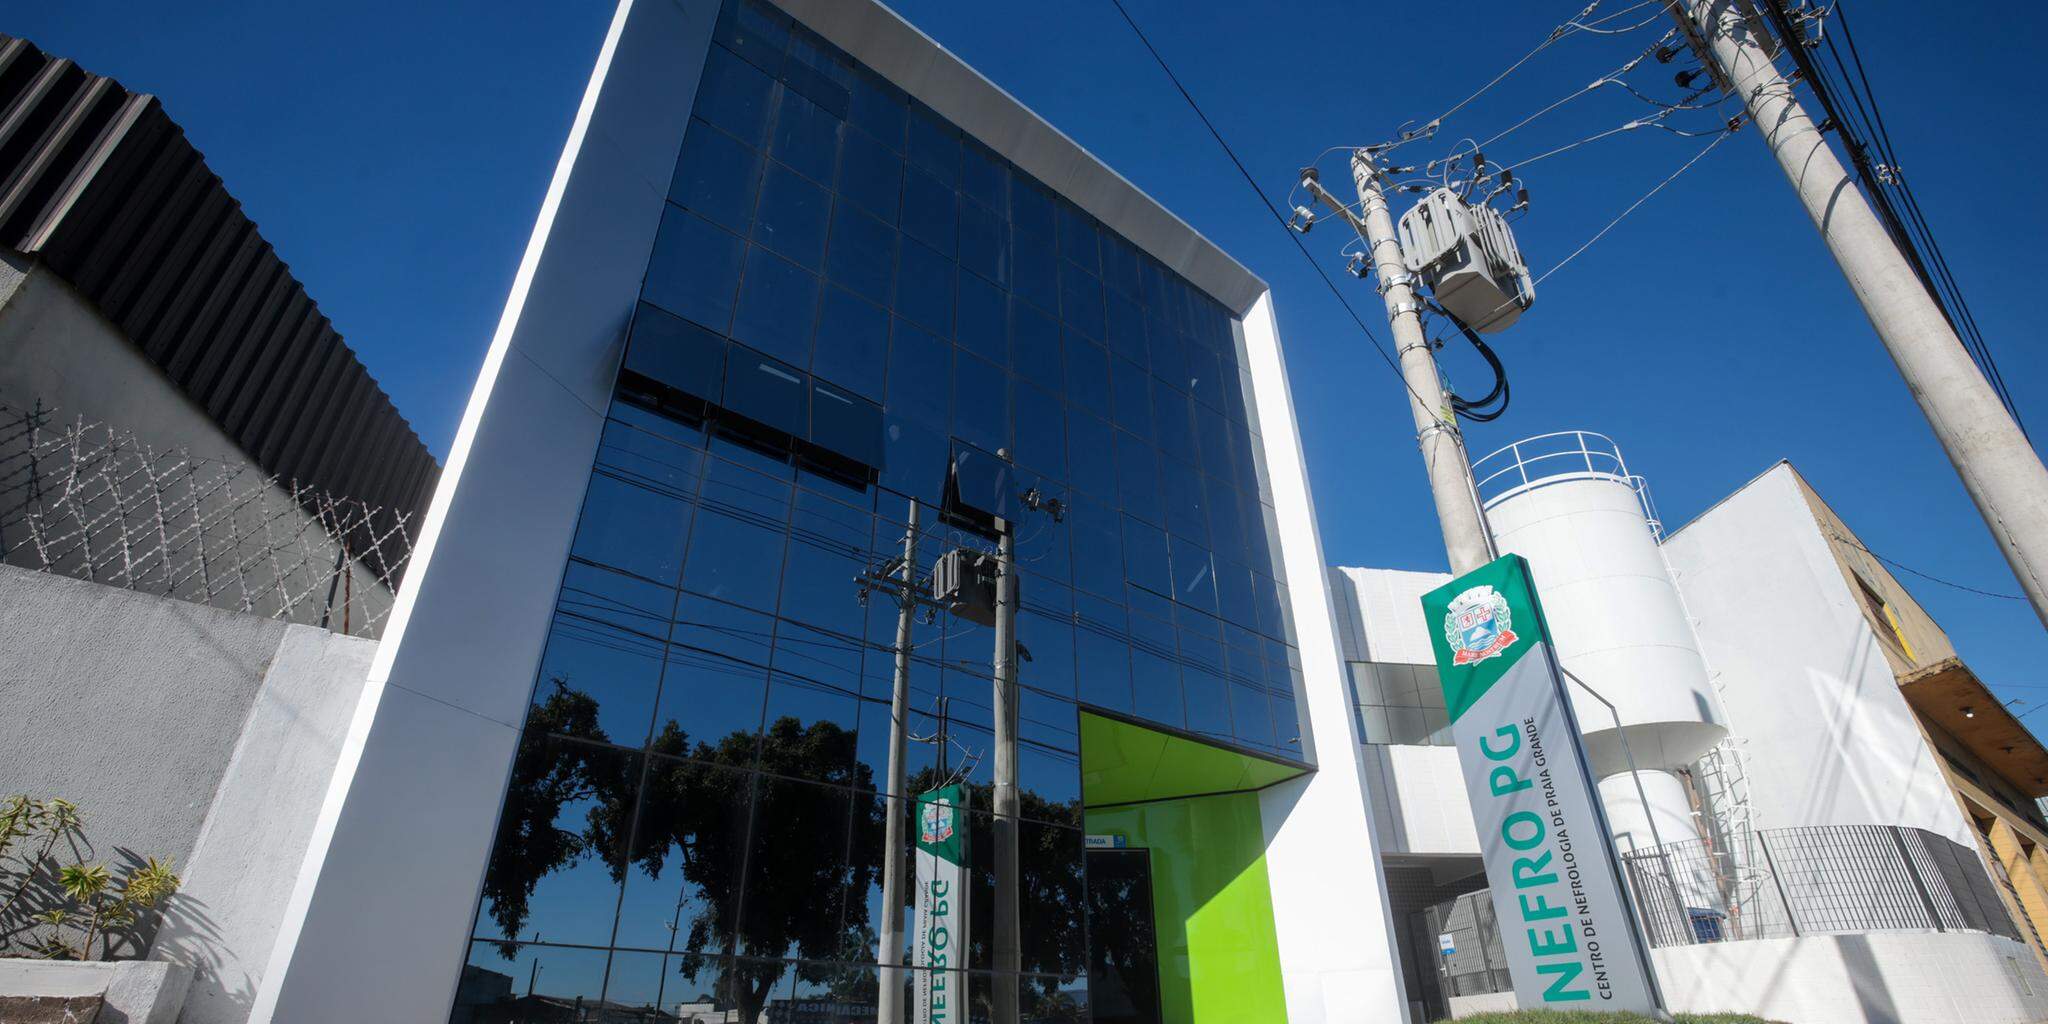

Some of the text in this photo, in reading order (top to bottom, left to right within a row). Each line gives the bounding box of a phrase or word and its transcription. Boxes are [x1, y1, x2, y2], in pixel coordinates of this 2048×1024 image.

[1480, 723, 1591, 1002] NEFRO PG
[1523, 717, 1612, 1000] CENTRO DE NEFROLOGIA DE PRAIA GRANDE
